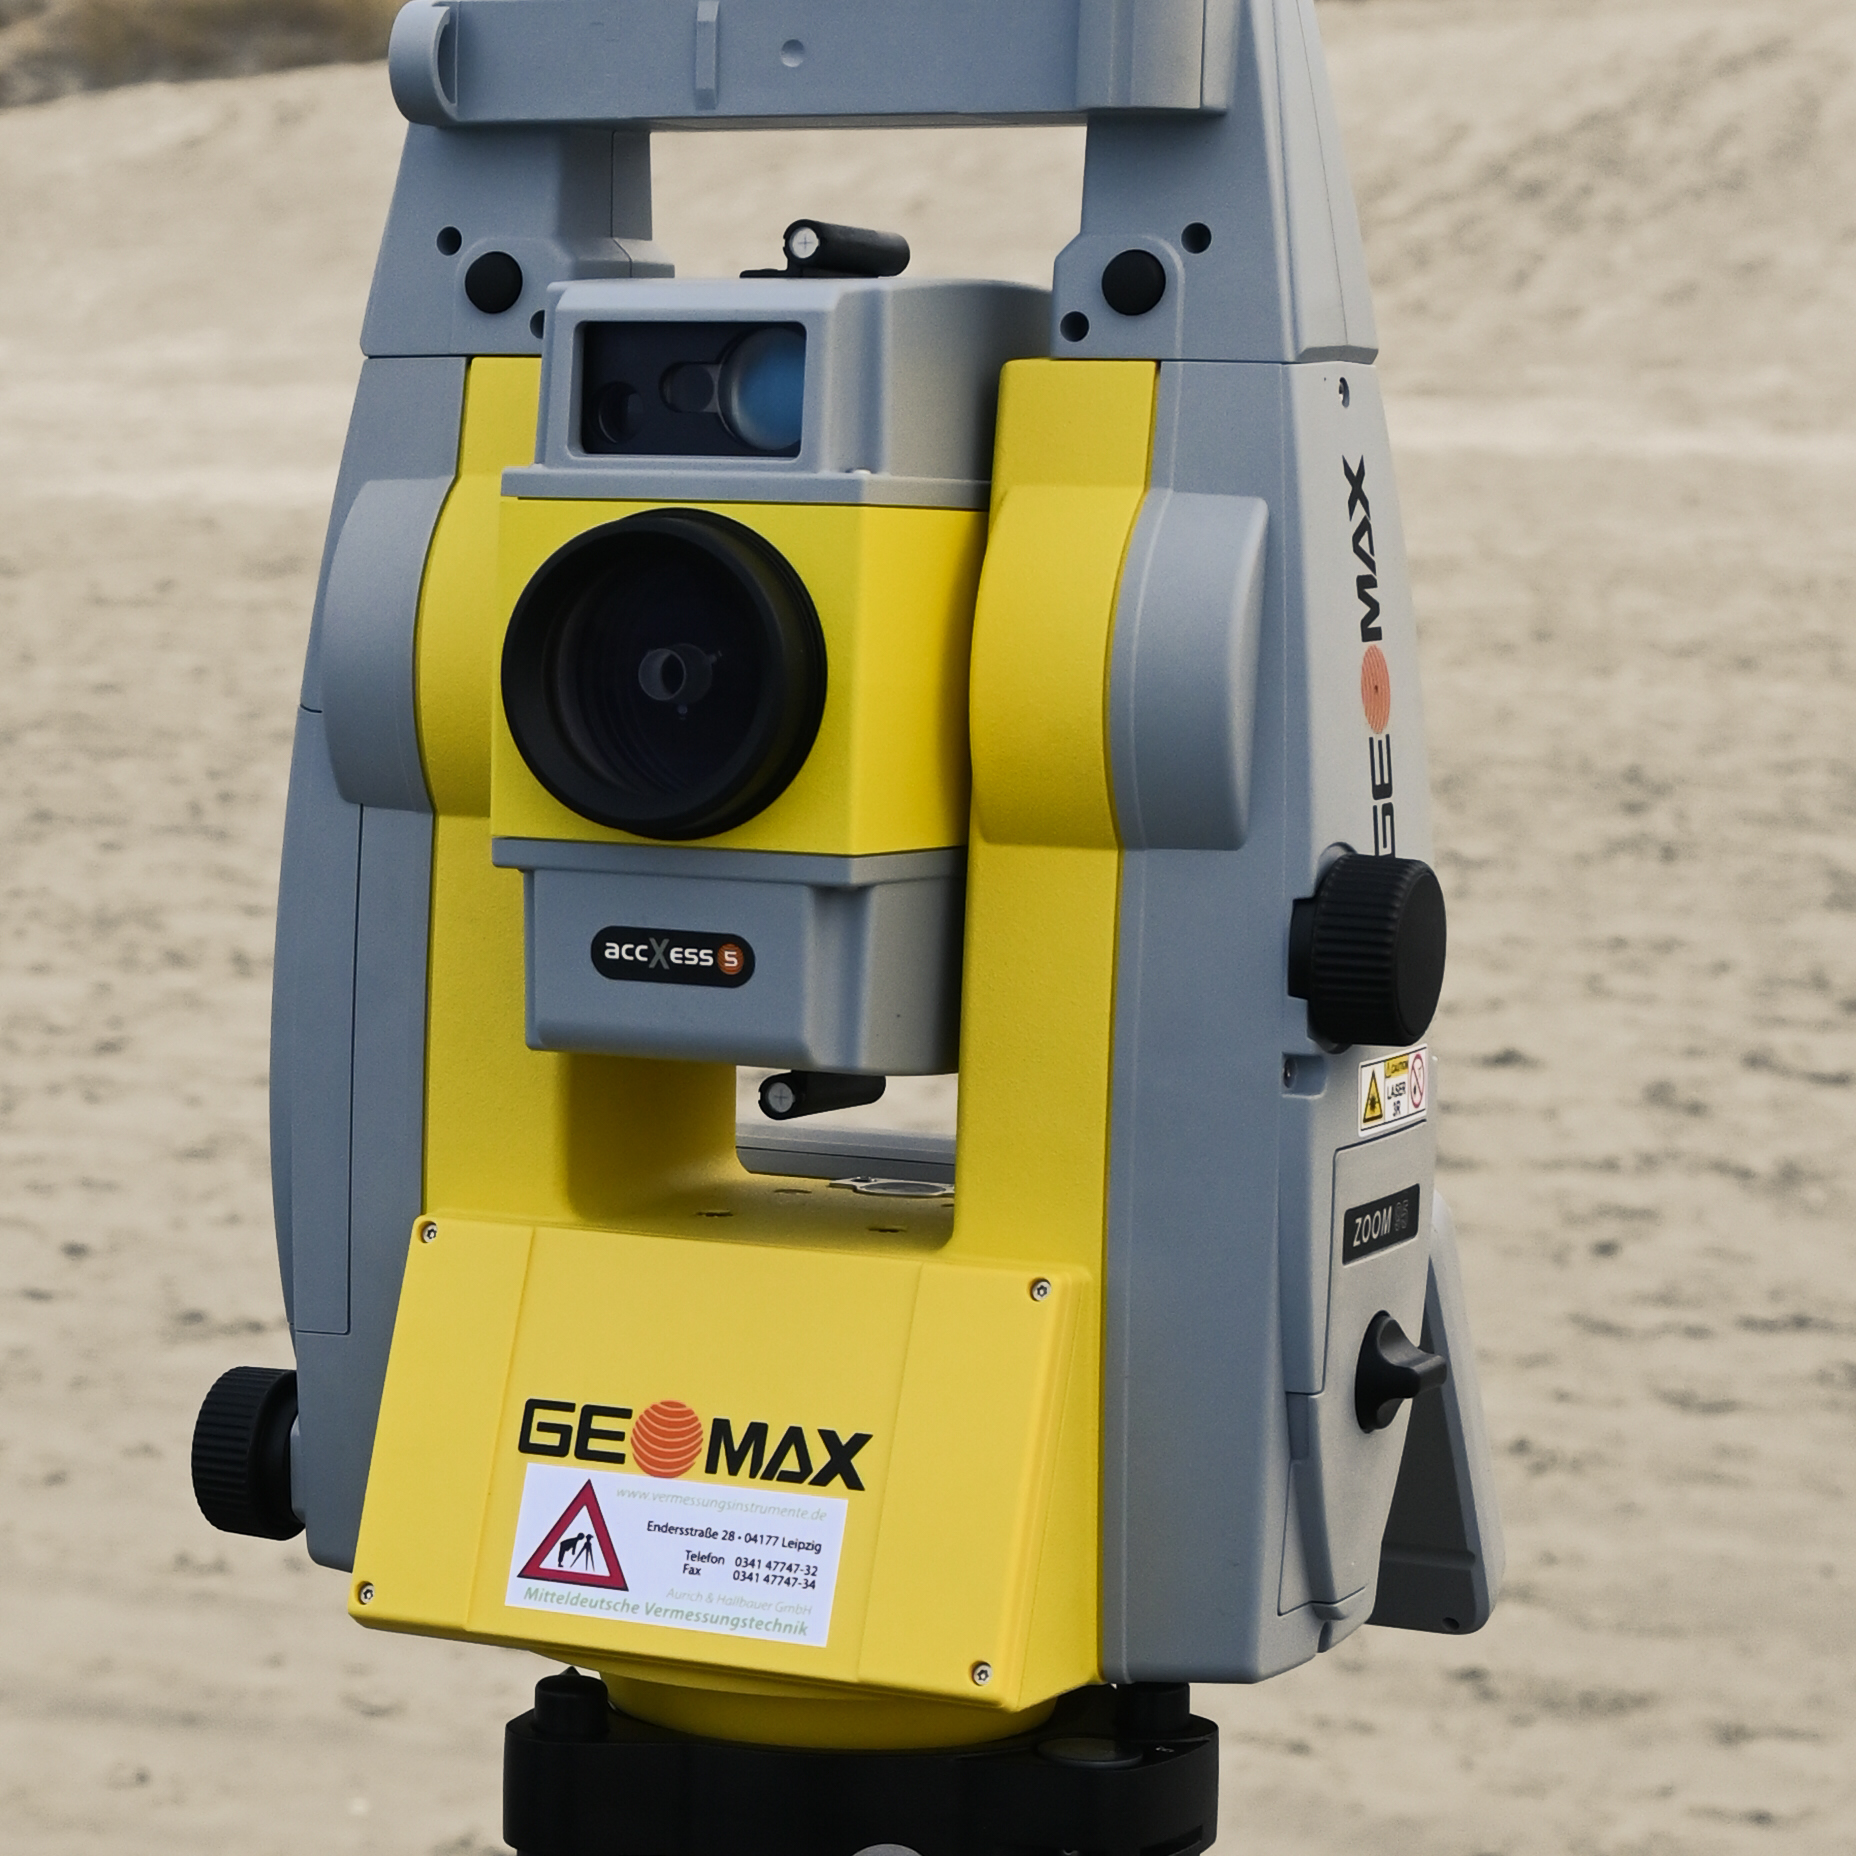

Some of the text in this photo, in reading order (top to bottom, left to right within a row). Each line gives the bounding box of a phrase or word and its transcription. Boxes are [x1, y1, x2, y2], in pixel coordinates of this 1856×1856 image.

[723, 949, 739, 968] 5
[1386, 1081, 1407, 1100] LASER
[1352, 1205, 1393, 1248] ZOOM
[517, 1397, 874, 1492] GEOMAX
[615, 1488, 828, 1522] www.vermessungsinstrumente.de
[646, 1520, 823, 1555] Endersstraße 28 04177 Leipzig
[682, 1563, 816, 1590] Fax 0341 47747-34
[685, 1549, 819, 1577] Telefon 0341 47747-32
[523, 1586, 809, 1637] Mitteldeutsche Vermessungstechnik
[666, 1587, 813, 1616] Aurich & Hallbauer GmbH
